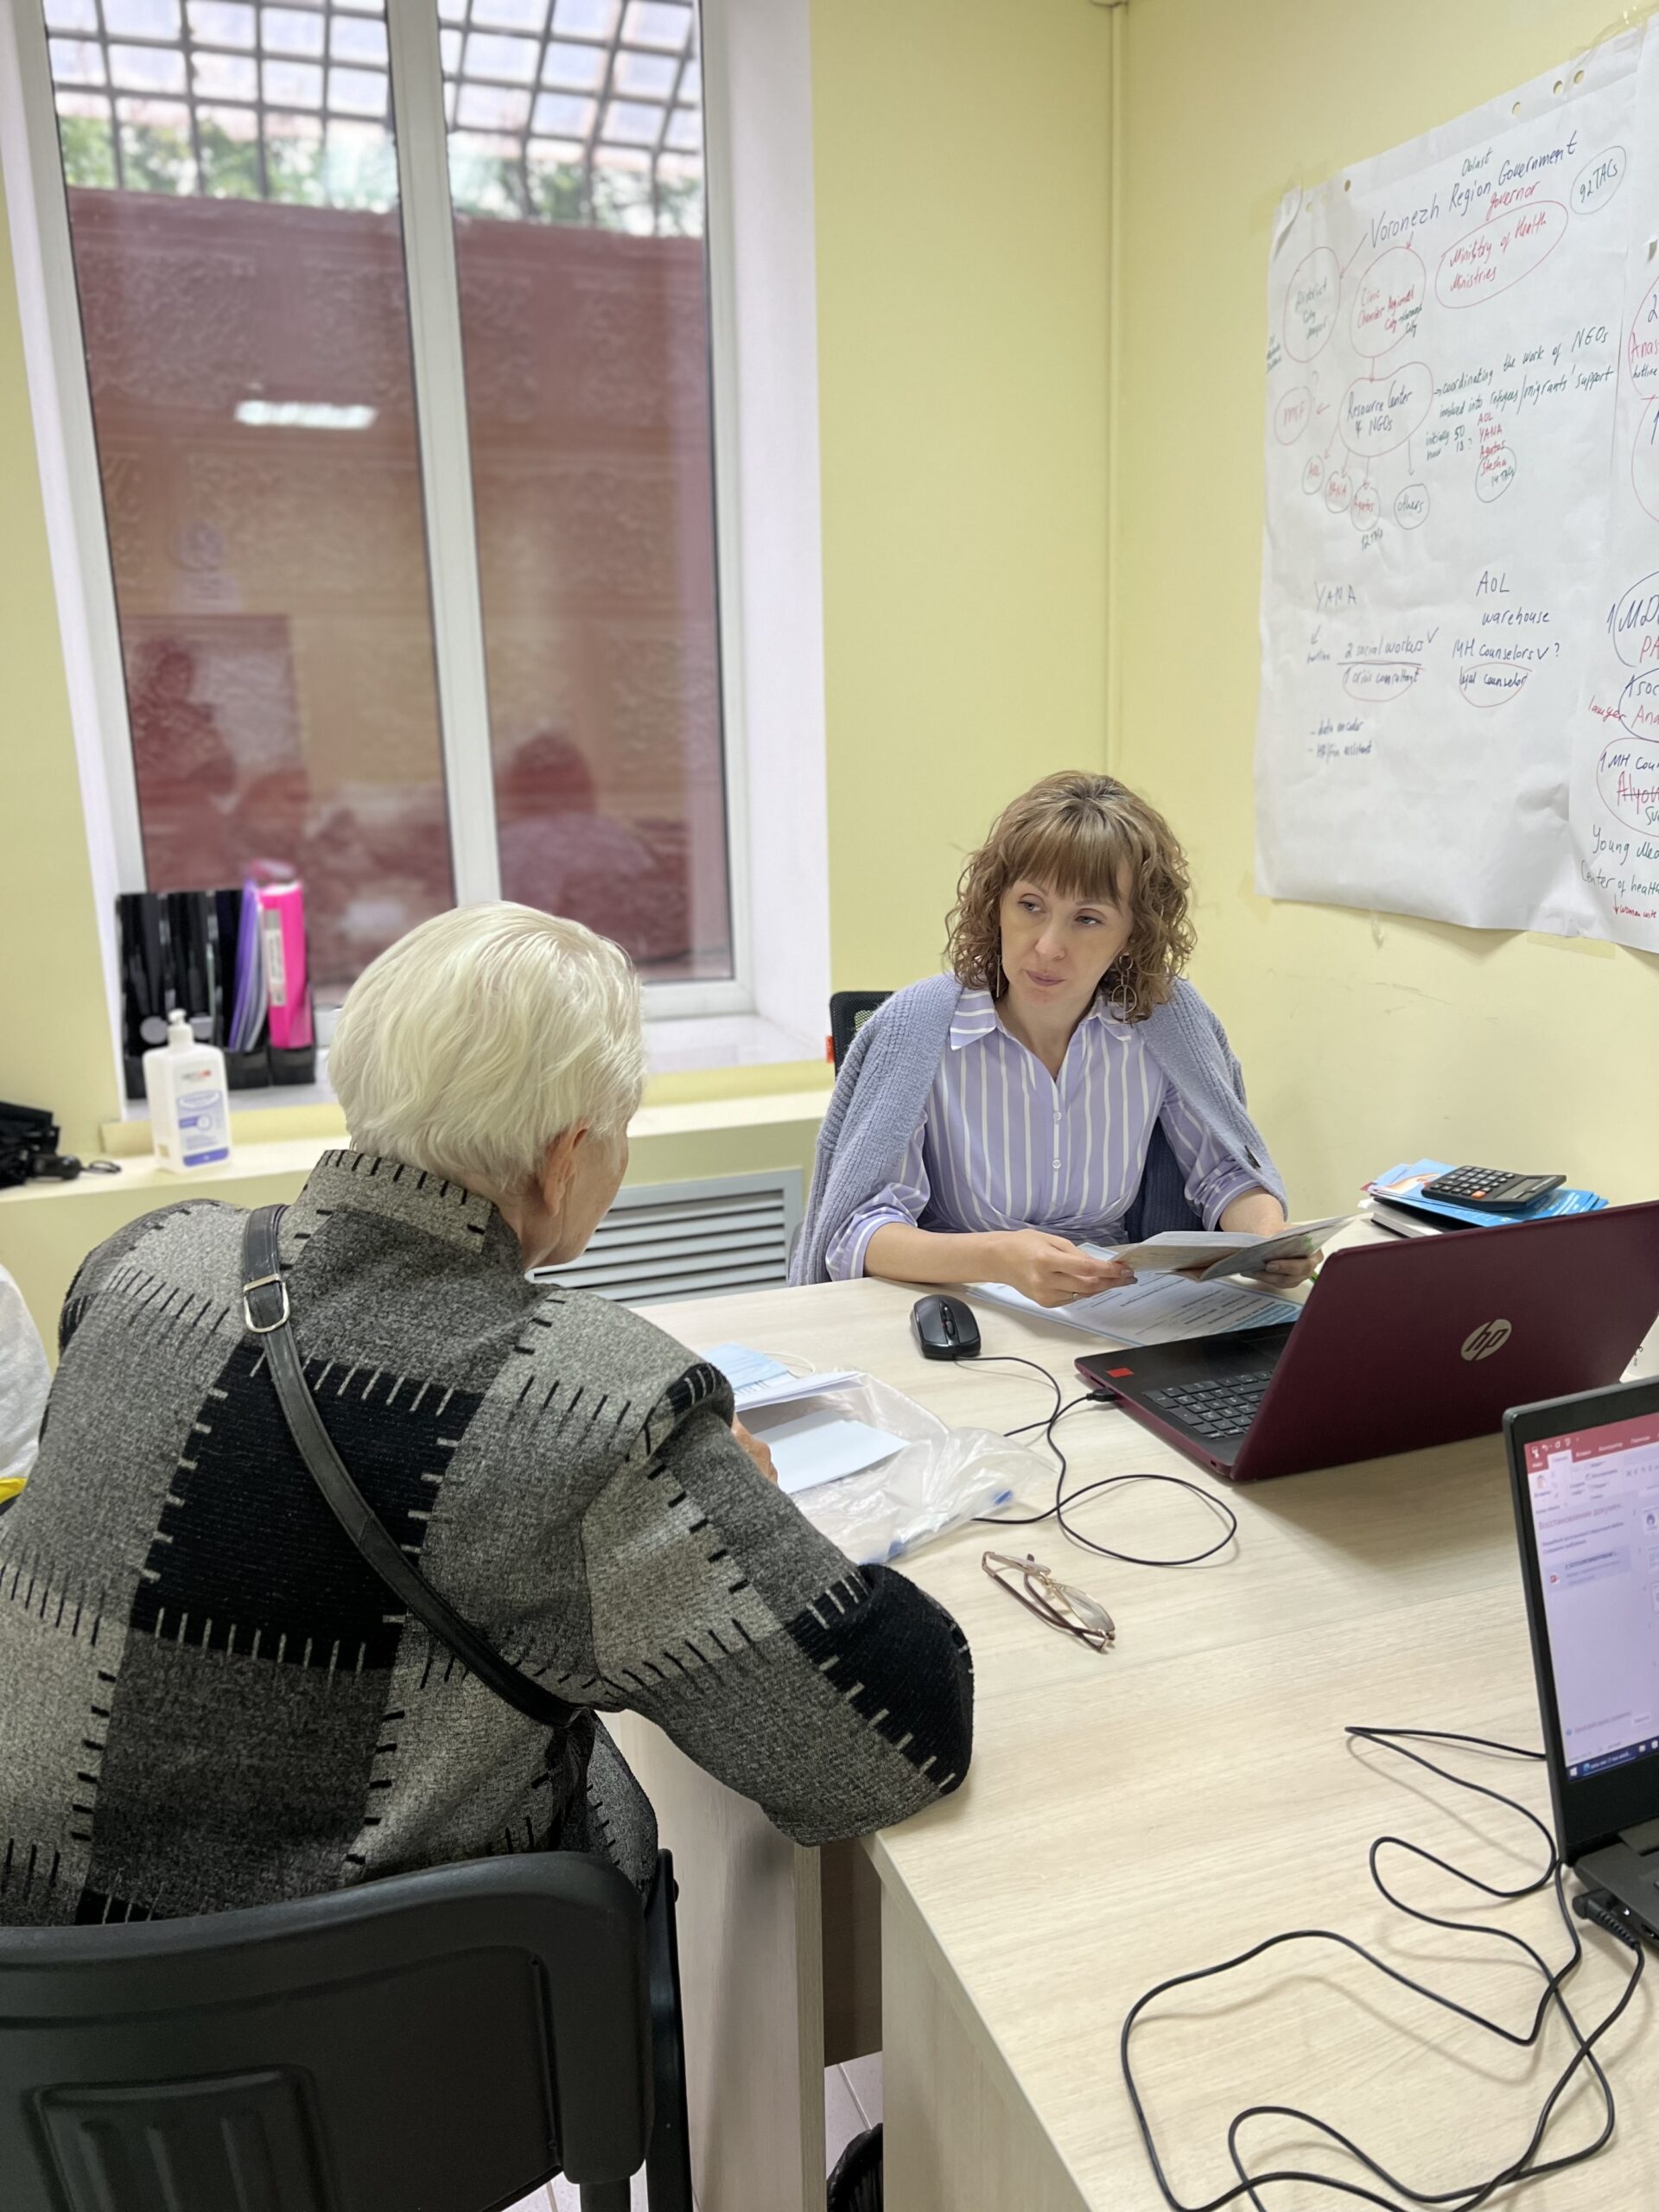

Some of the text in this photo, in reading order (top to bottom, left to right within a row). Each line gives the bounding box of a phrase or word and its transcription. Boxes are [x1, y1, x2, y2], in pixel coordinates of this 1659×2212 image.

[1371, 130, 1578, 249] Voronezh Region Government
[1514, 211, 1548, 239] Health
[1630, 331, 1659, 364] Anas
[1574, 365, 1615, 392] support
[1482, 607, 1551, 626] warehouse
[1592, 823, 1630, 866] Young
[1465, 1322, 1509, 1360] hp
